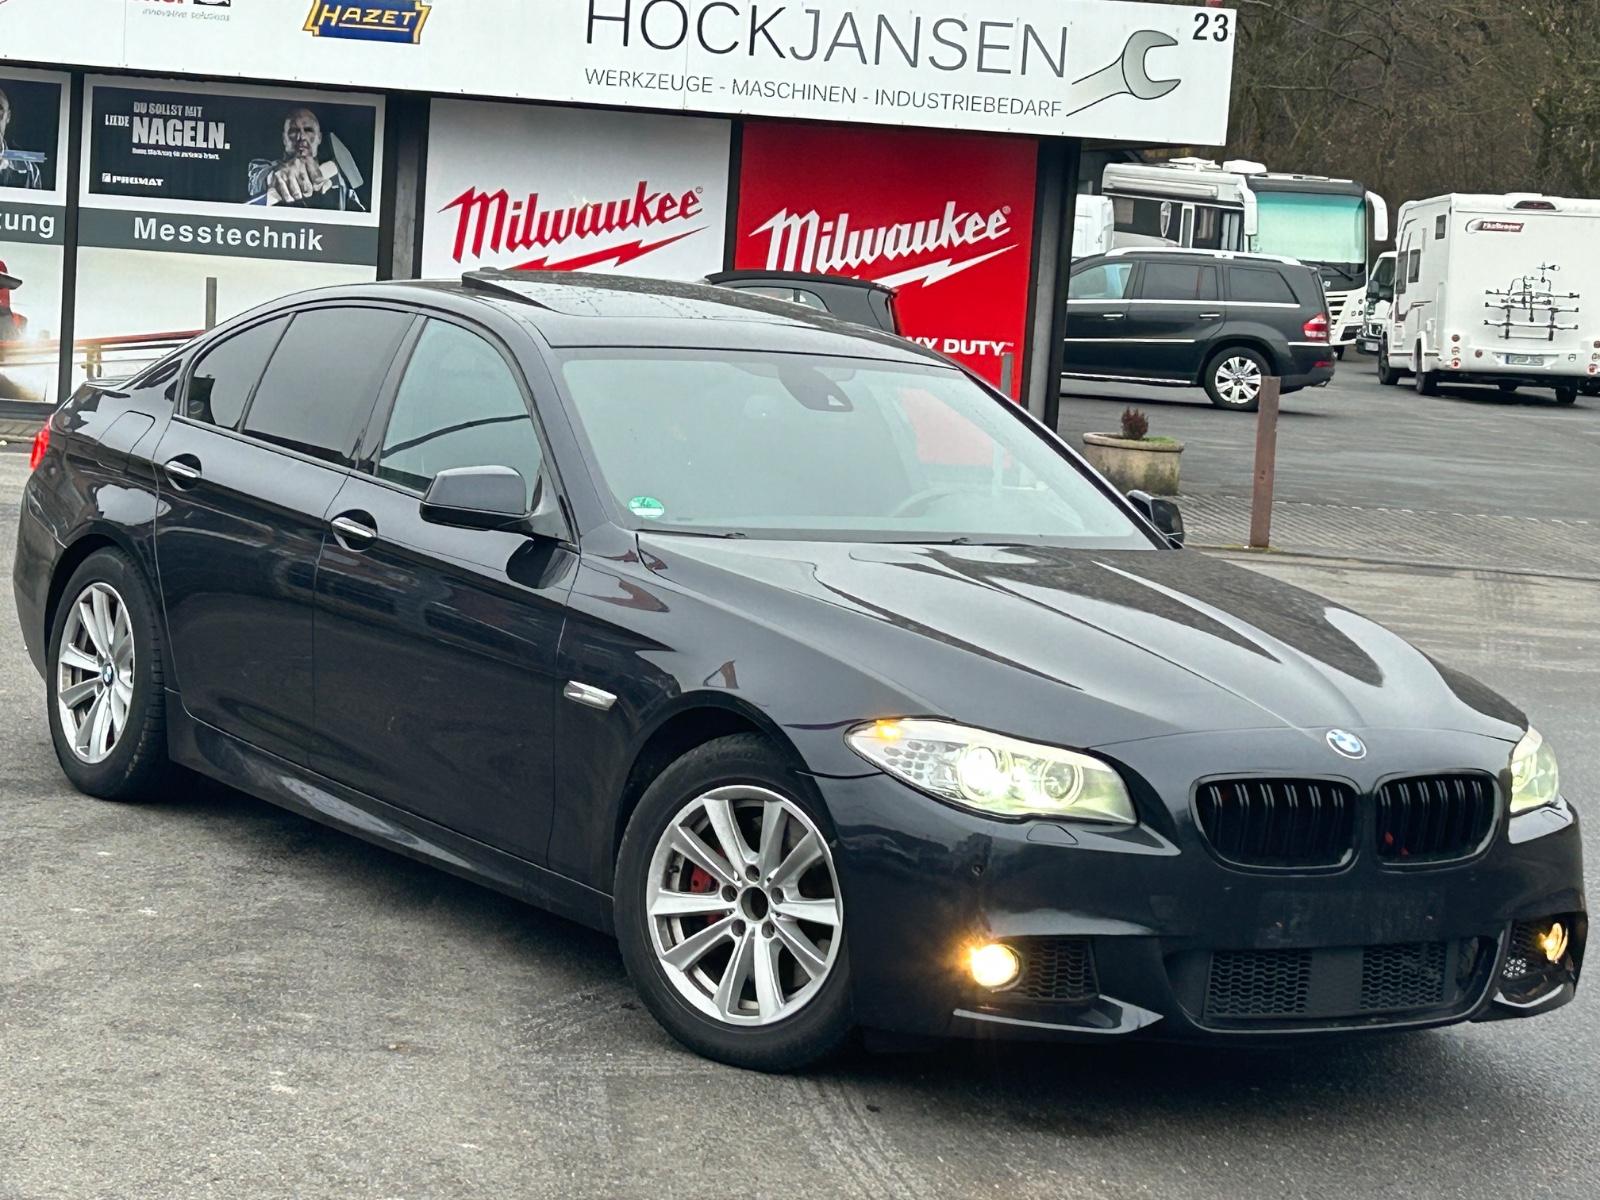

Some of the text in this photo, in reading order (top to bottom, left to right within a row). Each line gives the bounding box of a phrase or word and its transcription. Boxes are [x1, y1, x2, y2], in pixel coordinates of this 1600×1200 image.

[318, 4, 417, 26] HAZET
[1193, 12, 1229, 42] 23
[586, 0, 1067, 79] HOCKJANSEN
[585, 68, 713, 94] WERKZEUGE
[732, 78, 857, 104] MASCHINEN
[875, 88, 1062, 118] INDUSTRIEBEDARF
[133, 101, 203, 118] DU SOLLST MIT
[132, 116, 231, 150] NAGELN.
[0, 213, 55, 239] ung
[134, 217, 323, 251] Messtechnik
